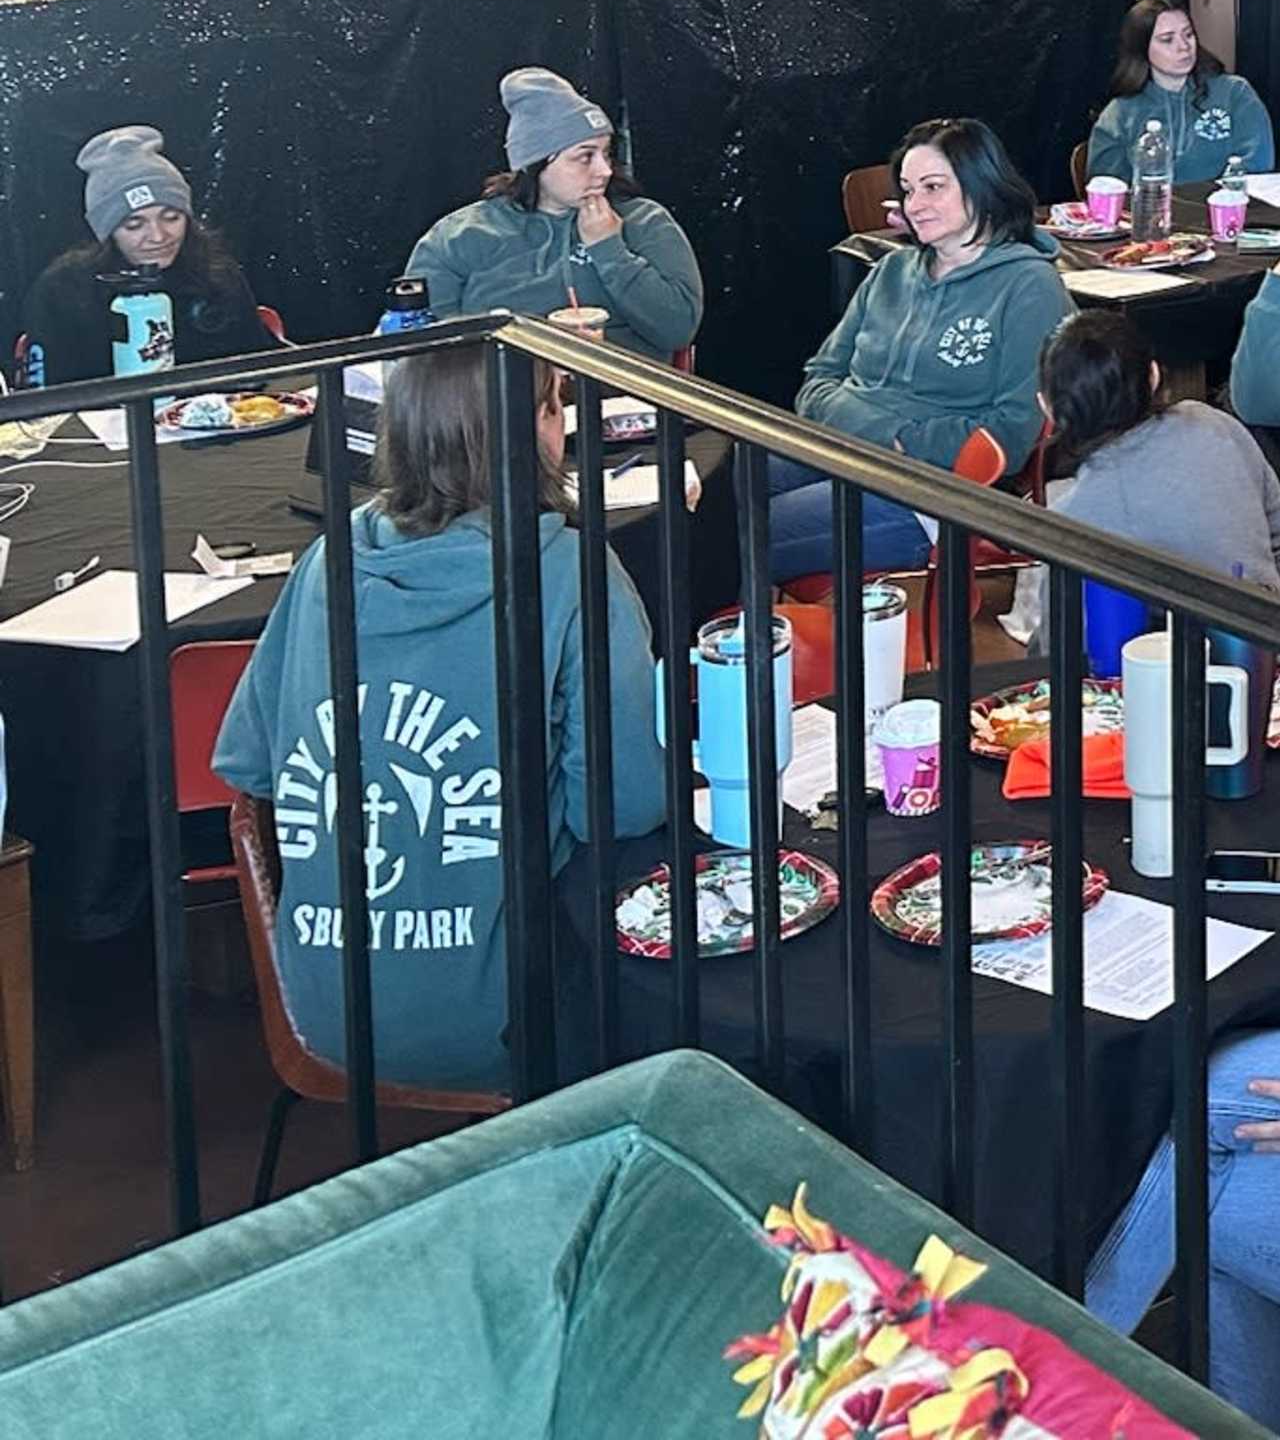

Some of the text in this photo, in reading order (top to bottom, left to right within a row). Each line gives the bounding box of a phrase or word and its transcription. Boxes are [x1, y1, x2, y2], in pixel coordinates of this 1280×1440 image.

[275, 737, 326, 860] CITY
[384, 681, 481, 771] THE
[441, 766, 503, 865] SEA
[393, 906, 475, 950] PARK
